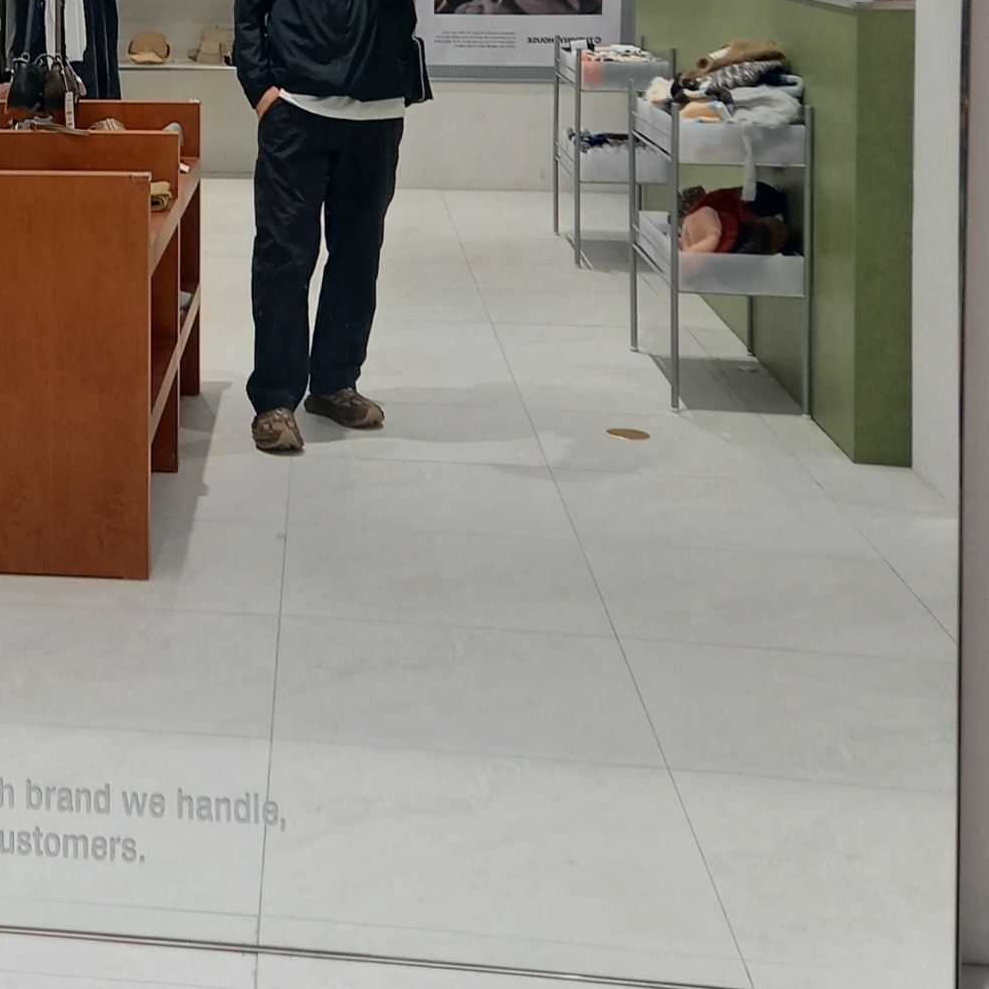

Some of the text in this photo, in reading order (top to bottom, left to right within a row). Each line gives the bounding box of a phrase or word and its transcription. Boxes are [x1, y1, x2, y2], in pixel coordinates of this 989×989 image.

[26, 778, 111, 815] brand
[122, 790, 166, 818] we
[177, 788, 286, 832] handle,
